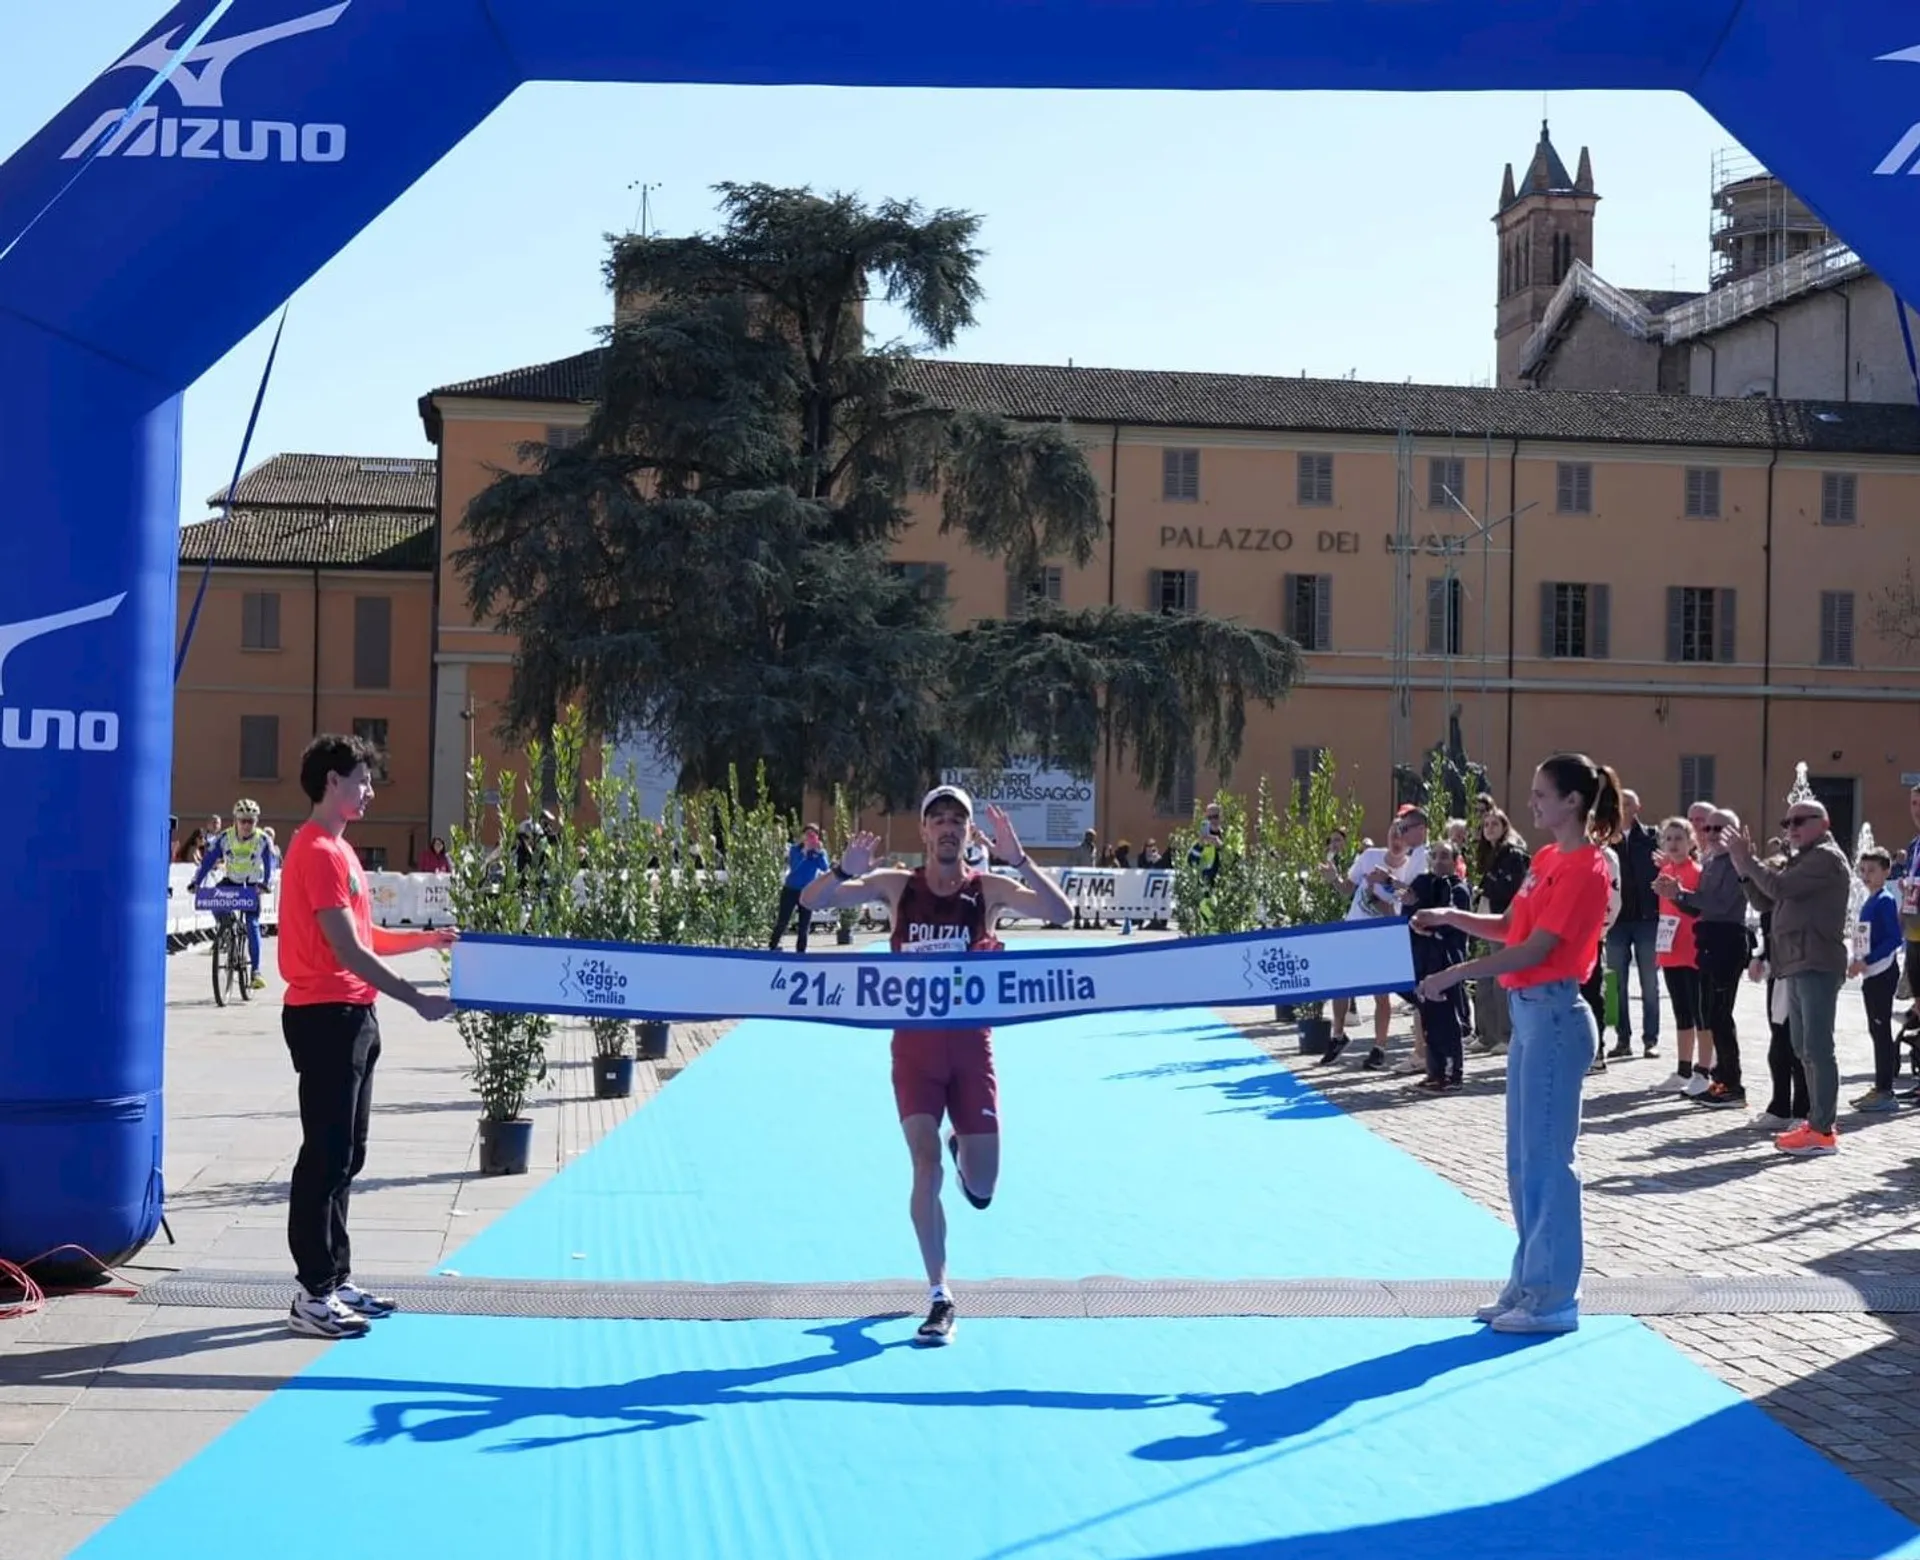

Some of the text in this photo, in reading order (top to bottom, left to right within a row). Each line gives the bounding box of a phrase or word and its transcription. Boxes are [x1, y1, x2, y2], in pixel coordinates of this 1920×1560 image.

[60, 105, 346, 162] MIZUNO
[1160, 526, 1293, 551] PALAZZO
[1317, 530, 1360, 554] DEI
[1006, 787, 1091, 800] PASSAGGIO
[908, 923, 971, 944] POLIZIA
[1269, 947, 1285, 961] 21
[590, 959, 606, 974] 21
[1257, 956, 1310, 976] Reggio
[576, 969, 628, 991] Reggio
[770, 966, 1096, 1017] la 21 di Reggio Emilia
